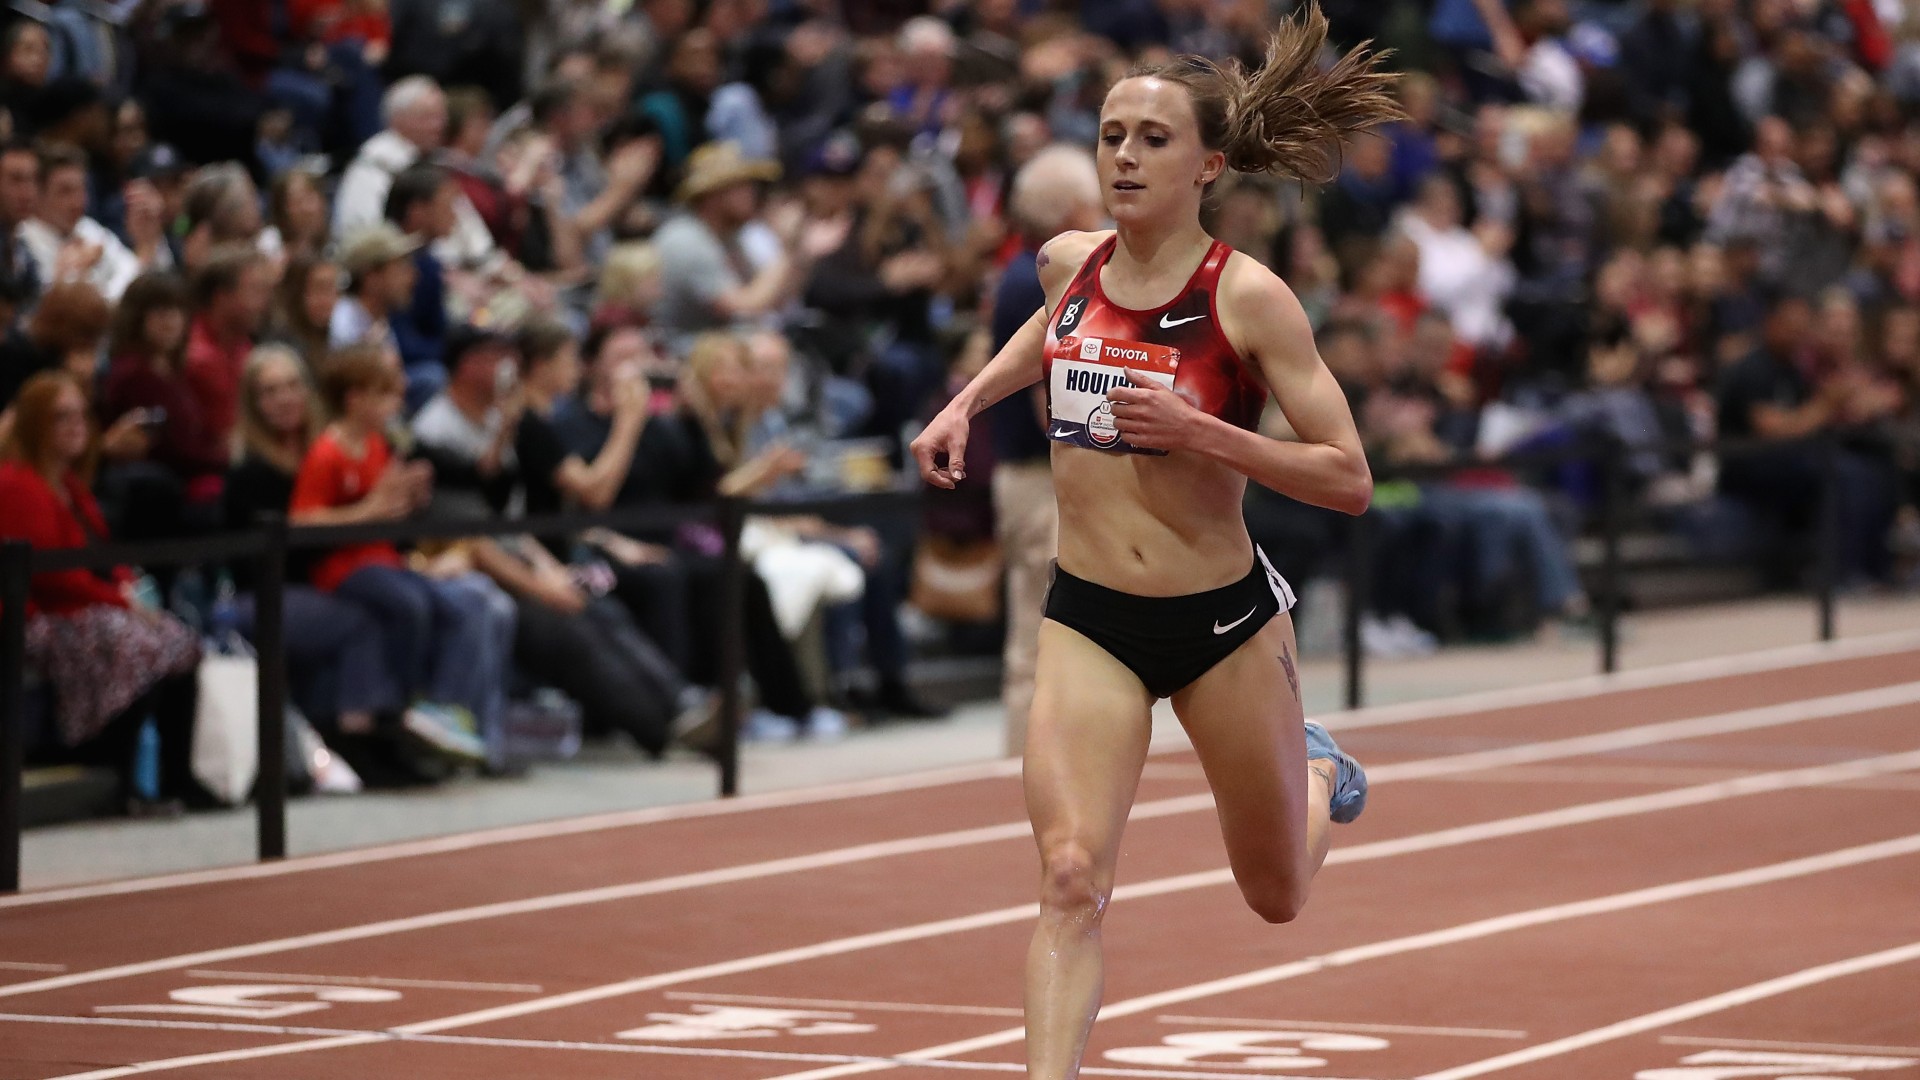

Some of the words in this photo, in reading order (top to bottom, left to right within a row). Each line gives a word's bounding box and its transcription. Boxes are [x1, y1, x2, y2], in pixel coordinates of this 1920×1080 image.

[1104, 346, 1149, 361] TOYOTA
[1065, 368, 1137, 396] HOULIH
[93, 983, 402, 1020] 5
[1103, 1030, 1390, 1070] 3
